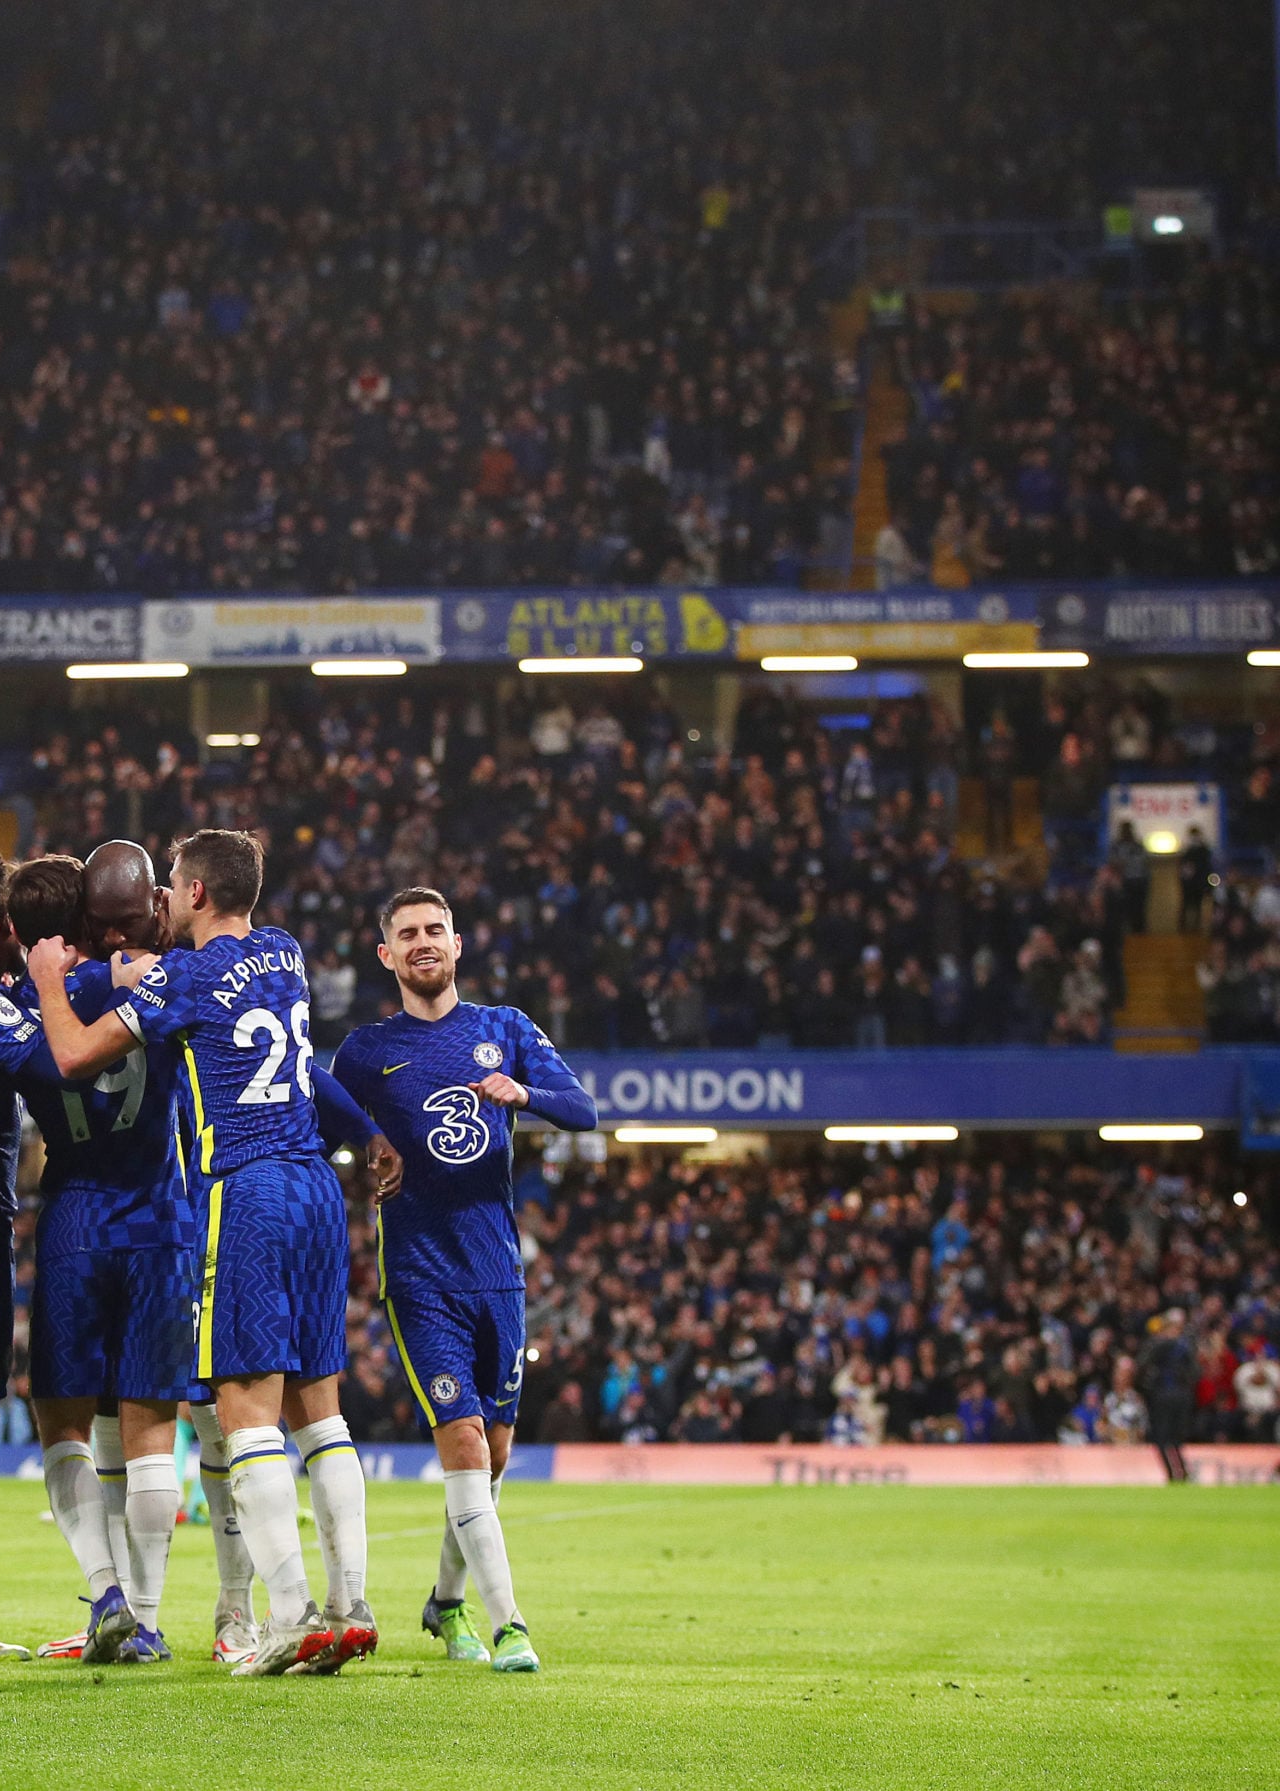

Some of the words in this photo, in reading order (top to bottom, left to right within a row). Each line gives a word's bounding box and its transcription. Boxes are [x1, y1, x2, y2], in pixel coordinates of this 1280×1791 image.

[510, 596, 667, 628] ATLANTA
[507, 625, 669, 658] BLUES
[232, 1000, 314, 1105] 28
[504, 1347, 525, 1392] 5
